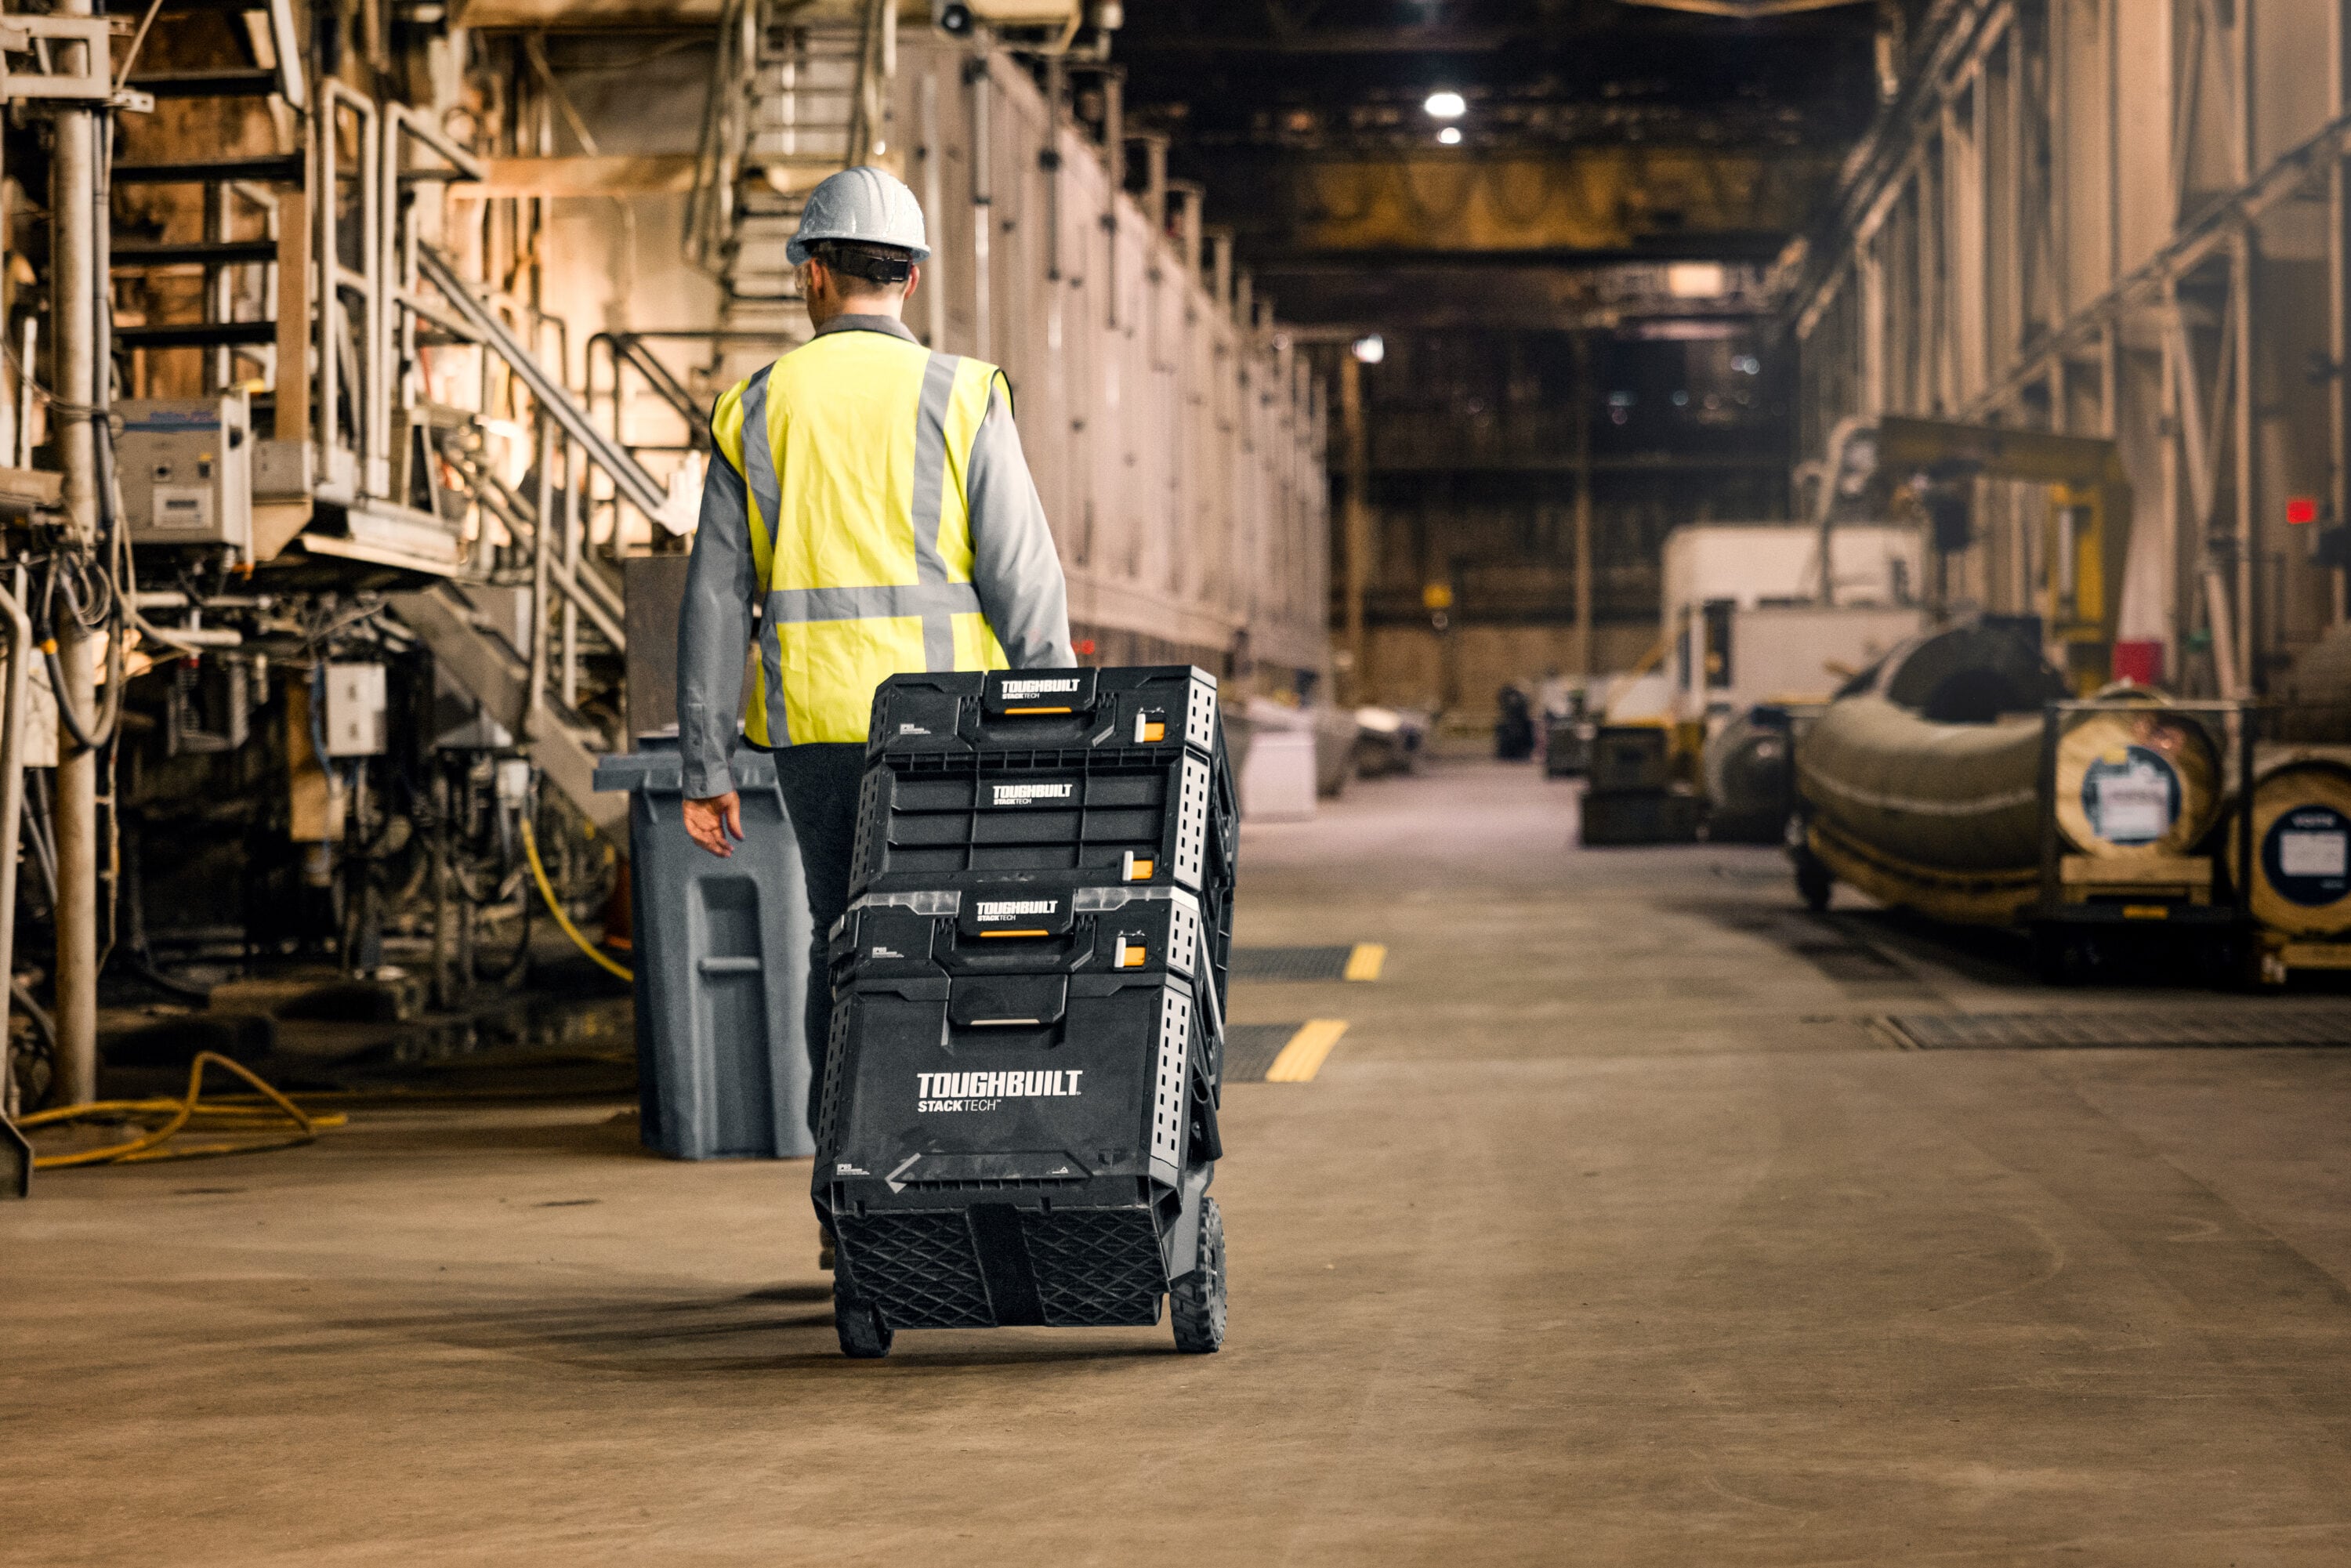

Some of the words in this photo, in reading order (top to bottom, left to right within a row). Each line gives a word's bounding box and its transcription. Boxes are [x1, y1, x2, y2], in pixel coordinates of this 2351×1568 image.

[1002, 678, 1081, 693] TOUGHBUILT
[993, 784, 1073, 799] TOUGHBUILT
[976, 900, 1058, 915] TOUGHBUILT
[917, 1070, 1083, 1099] TOUGHBUILT
